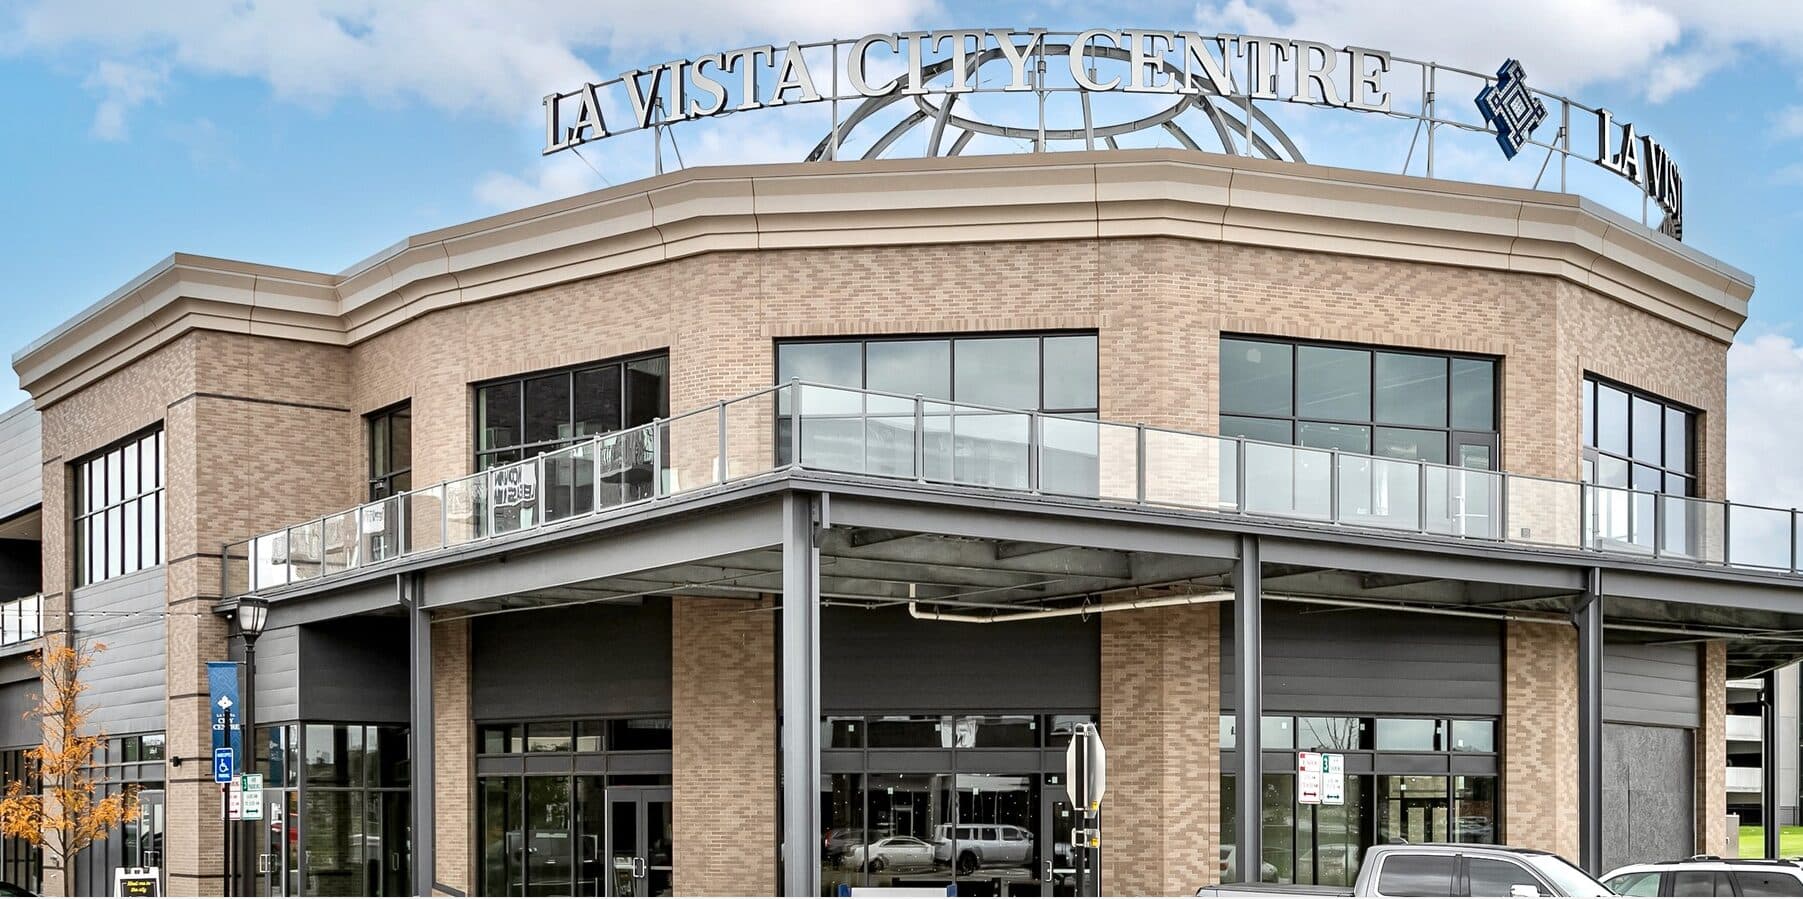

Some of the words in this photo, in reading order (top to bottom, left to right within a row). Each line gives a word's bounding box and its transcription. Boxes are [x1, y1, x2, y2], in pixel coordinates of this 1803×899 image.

[542, 82, 610, 156] LA
[620, 41, 822, 129] VISTA
[848, 27, 1047, 97] CITY
[1069, 28, 1391, 112] CENTRE
[1596, 108, 1642, 185] LA
